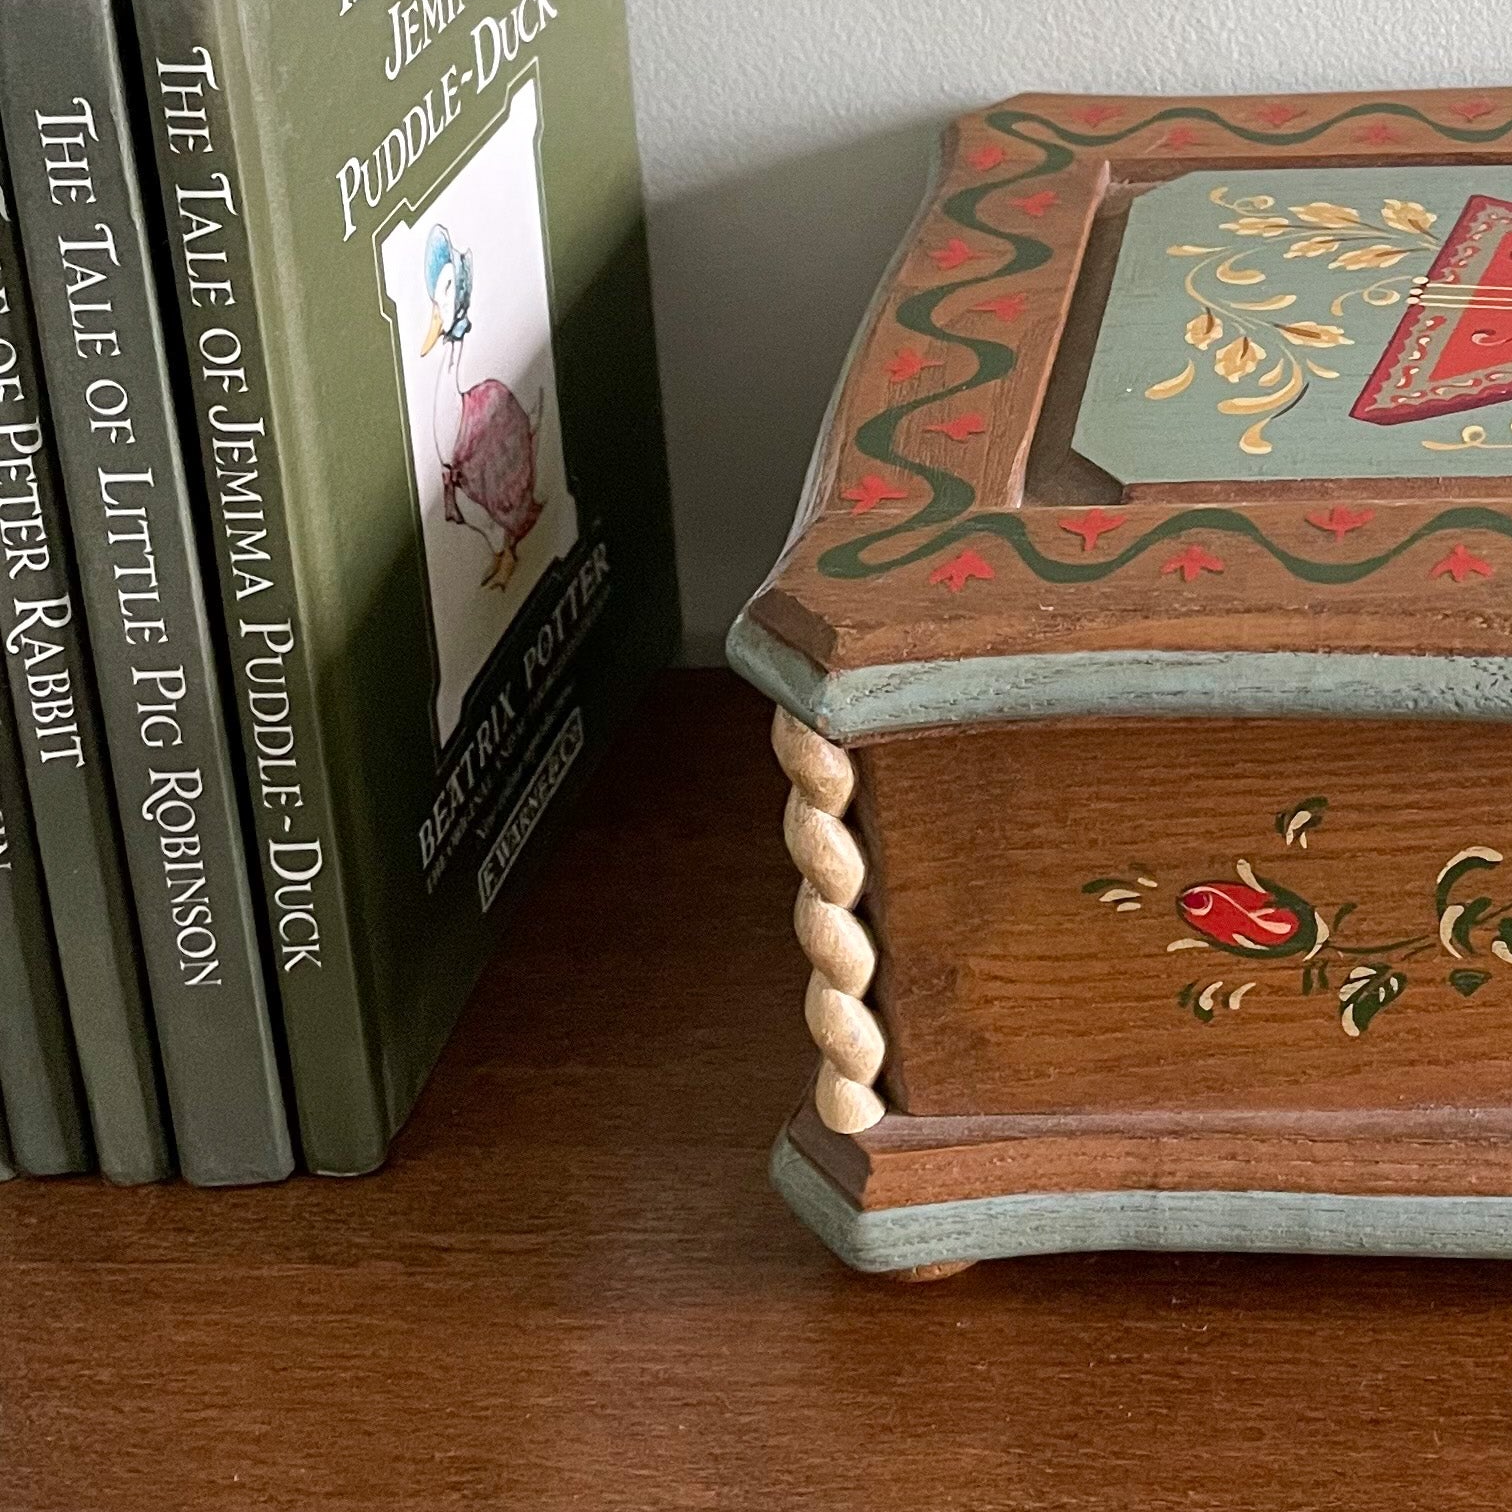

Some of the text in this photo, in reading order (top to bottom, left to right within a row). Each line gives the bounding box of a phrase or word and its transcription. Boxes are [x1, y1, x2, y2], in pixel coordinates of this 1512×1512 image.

[155, 46, 219, 154] THE
[175, 172, 237, 307] TALE
[199, 328, 249, 393] OF
[0, 417, 50, 580] PETER
[34, 97, 222, 986] THE TALE OF LITTLE PIG ROBINSON
[208, 405, 274, 601] JEMIMA
[5, 594, 85, 768] RABBIT
[418, 681, 515, 870] BEATRIX
[524, 541, 610, 690] POTTER
